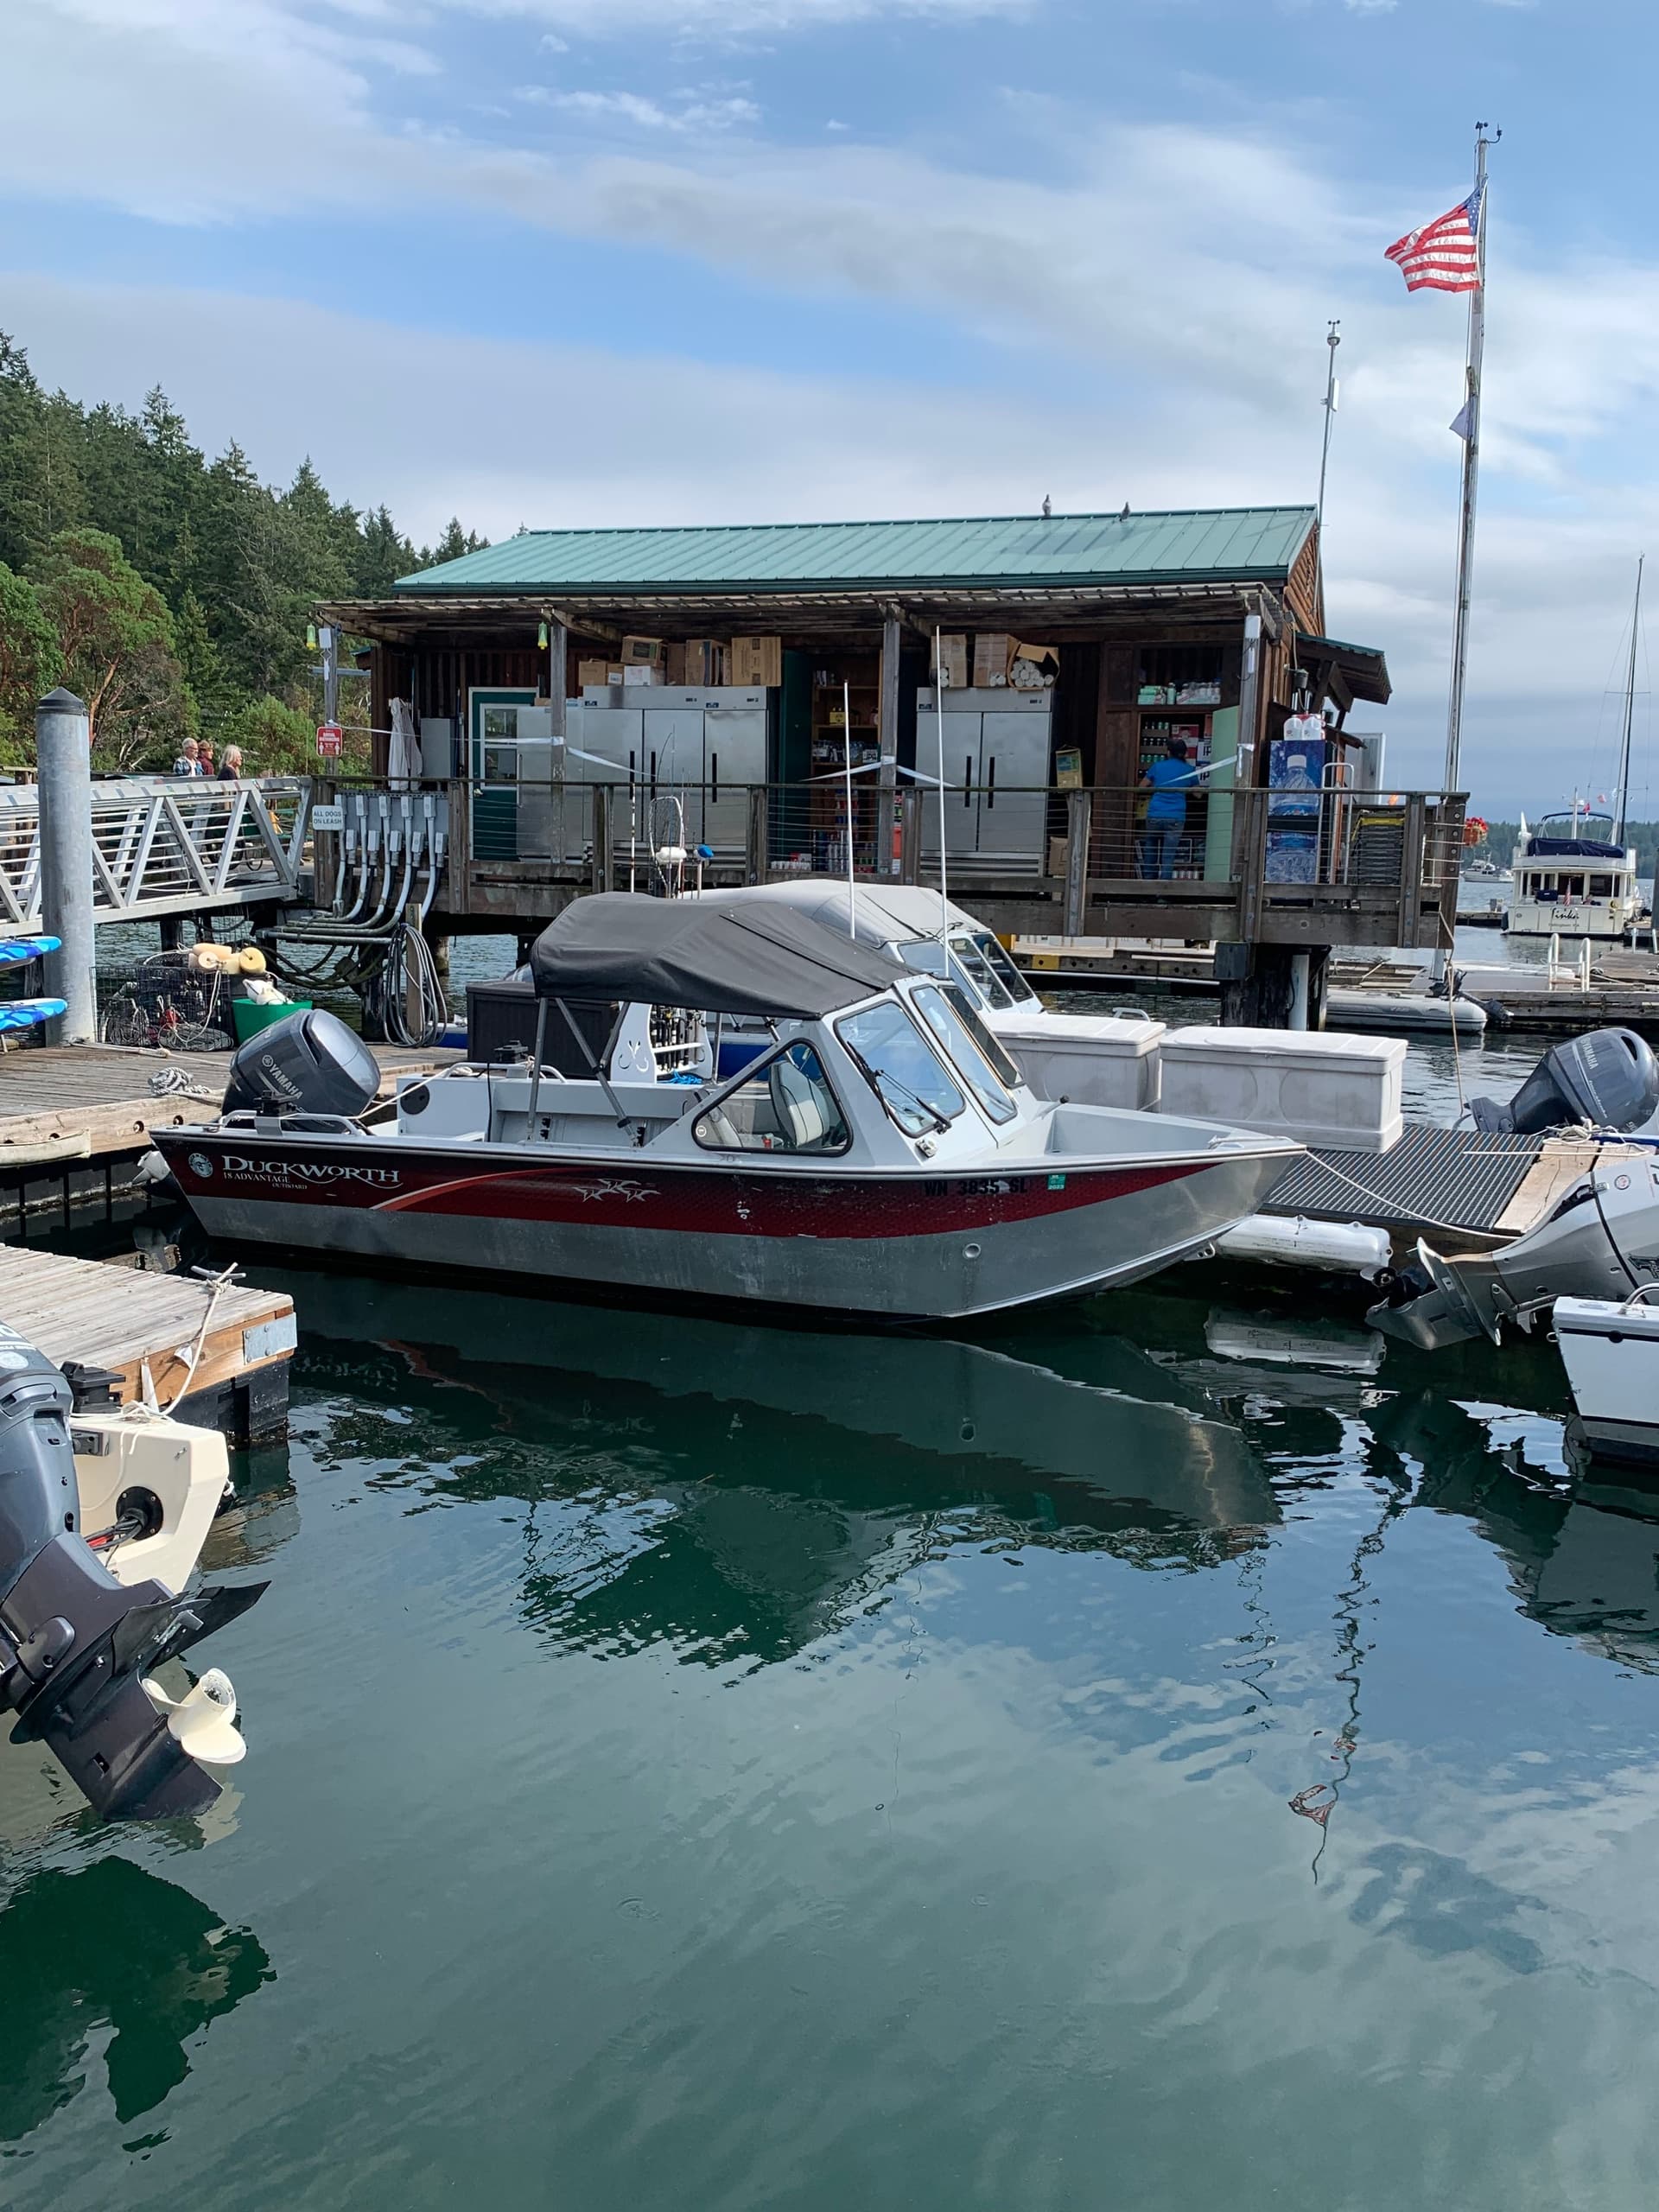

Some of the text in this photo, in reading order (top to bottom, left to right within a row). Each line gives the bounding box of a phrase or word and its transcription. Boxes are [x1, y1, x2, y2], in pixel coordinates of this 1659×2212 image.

[1581, 1043, 1599, 1070] YAMAHA
[269, 1064, 303, 1099] YAMAHA
[223, 1171, 291, 1185] 18 ADVANTAGE
[271, 1181, 308, 1191] OUTBOARD
[924, 1177, 1028, 1197] WN 3835 SL
